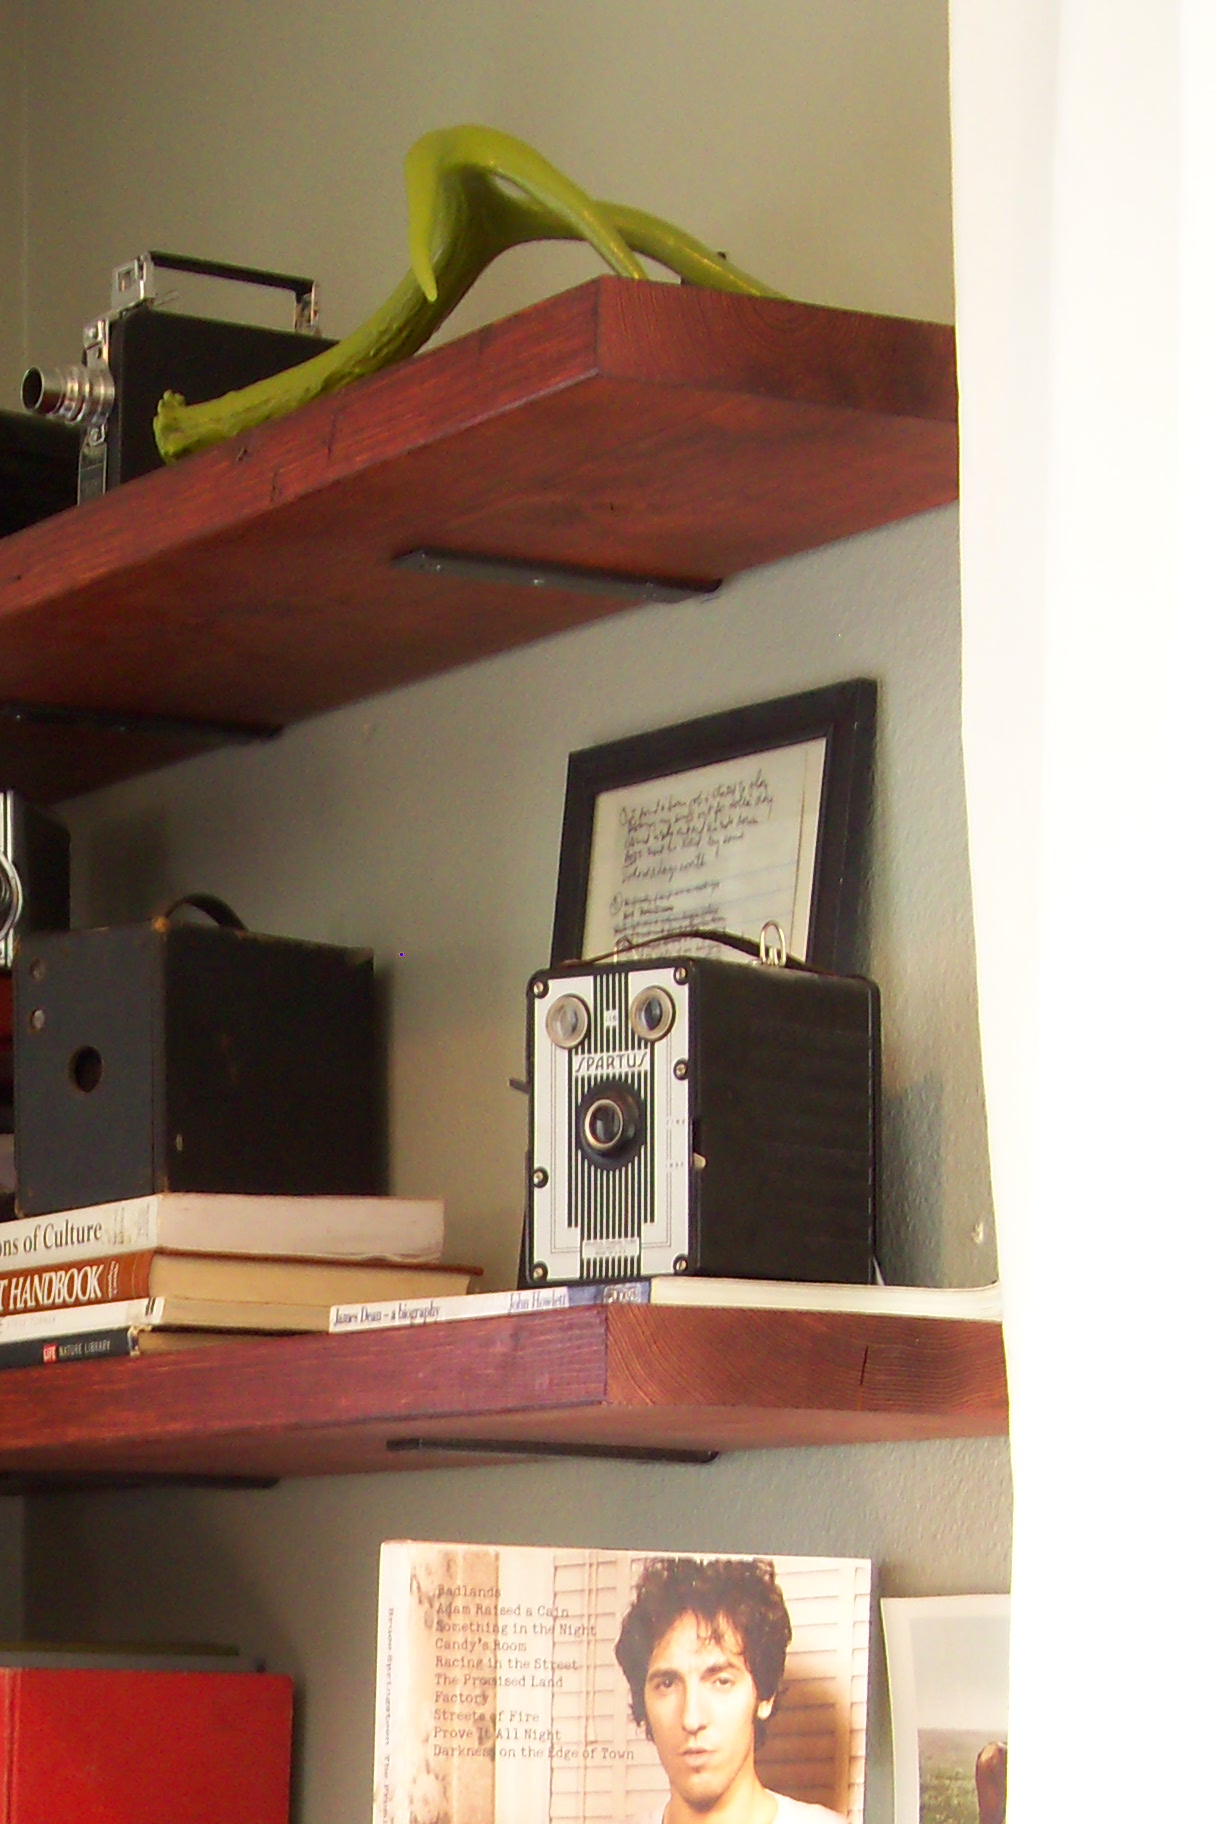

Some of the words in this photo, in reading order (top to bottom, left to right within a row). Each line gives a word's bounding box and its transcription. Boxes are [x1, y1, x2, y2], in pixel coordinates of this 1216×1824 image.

[575, 1051, 647, 1074] SPARTUS
[23, 1228, 40, 1252] of
[42, 1219, 103, 1249] Culture
[8, 1264, 104, 1310] HANDBOOK
[508, 1291, 525, 1314] John
[333, 1306, 358, 1326] James
[360, 1304, 382, 1323] Dean
[397, 1301, 441, 1327] biography
[44, 1345, 57, 1363] LIFE
[58, 1343, 82, 1358] NATURE
[84, 1339, 112, 1355] LIBRARY
[436, 1585, 502, 1599] Badlands
[436, 1603, 471, 1616] Adam
[475, 1604, 521, 1617] Raised
[525, 1607, 532, 1617] a
[537, 1604, 570, 1618] Cain
[435, 1619, 509, 1635] Something
[512, 1621, 528, 1634] in
[533, 1621, 555, 1635] the
[559, 1622, 597, 1638] Night
[435, 1637, 489, 1654] Candy's
[493, 1639, 527, 1652] Room
[435, 1655, 483, 1671] Racing
[487, 1656, 502, 1669] in
[507, 1657, 531, 1670] the
[534, 1658, 578, 1671] Street
[435, 1673, 460, 1686] The
[463, 1673, 526, 1687] Promised
[531, 1675, 564, 1689] Land
[384, 1655, 393, 1746] Springsteen
[434, 1690, 490, 1706] Factory
[433, 1708, 485, 1722] Streets
[488, 1709, 503, 1722] of
[509, 1710, 540, 1723] Fire
[433, 1726, 474, 1739] Prove
[477, 1727, 491, 1739] It
[495, 1727, 519, 1740] All
[523, 1728, 562, 1743] Night
[433, 1743, 496, 1758] Darkness
[499, 1747, 516, 1758] on
[520, 1746, 543, 1759] the
[547, 1746, 579, 1762] Edge
[582, 1746, 597, 1760] of
[601, 1747, 634, 1760] Town
[383, 1756, 391, 1780] The
